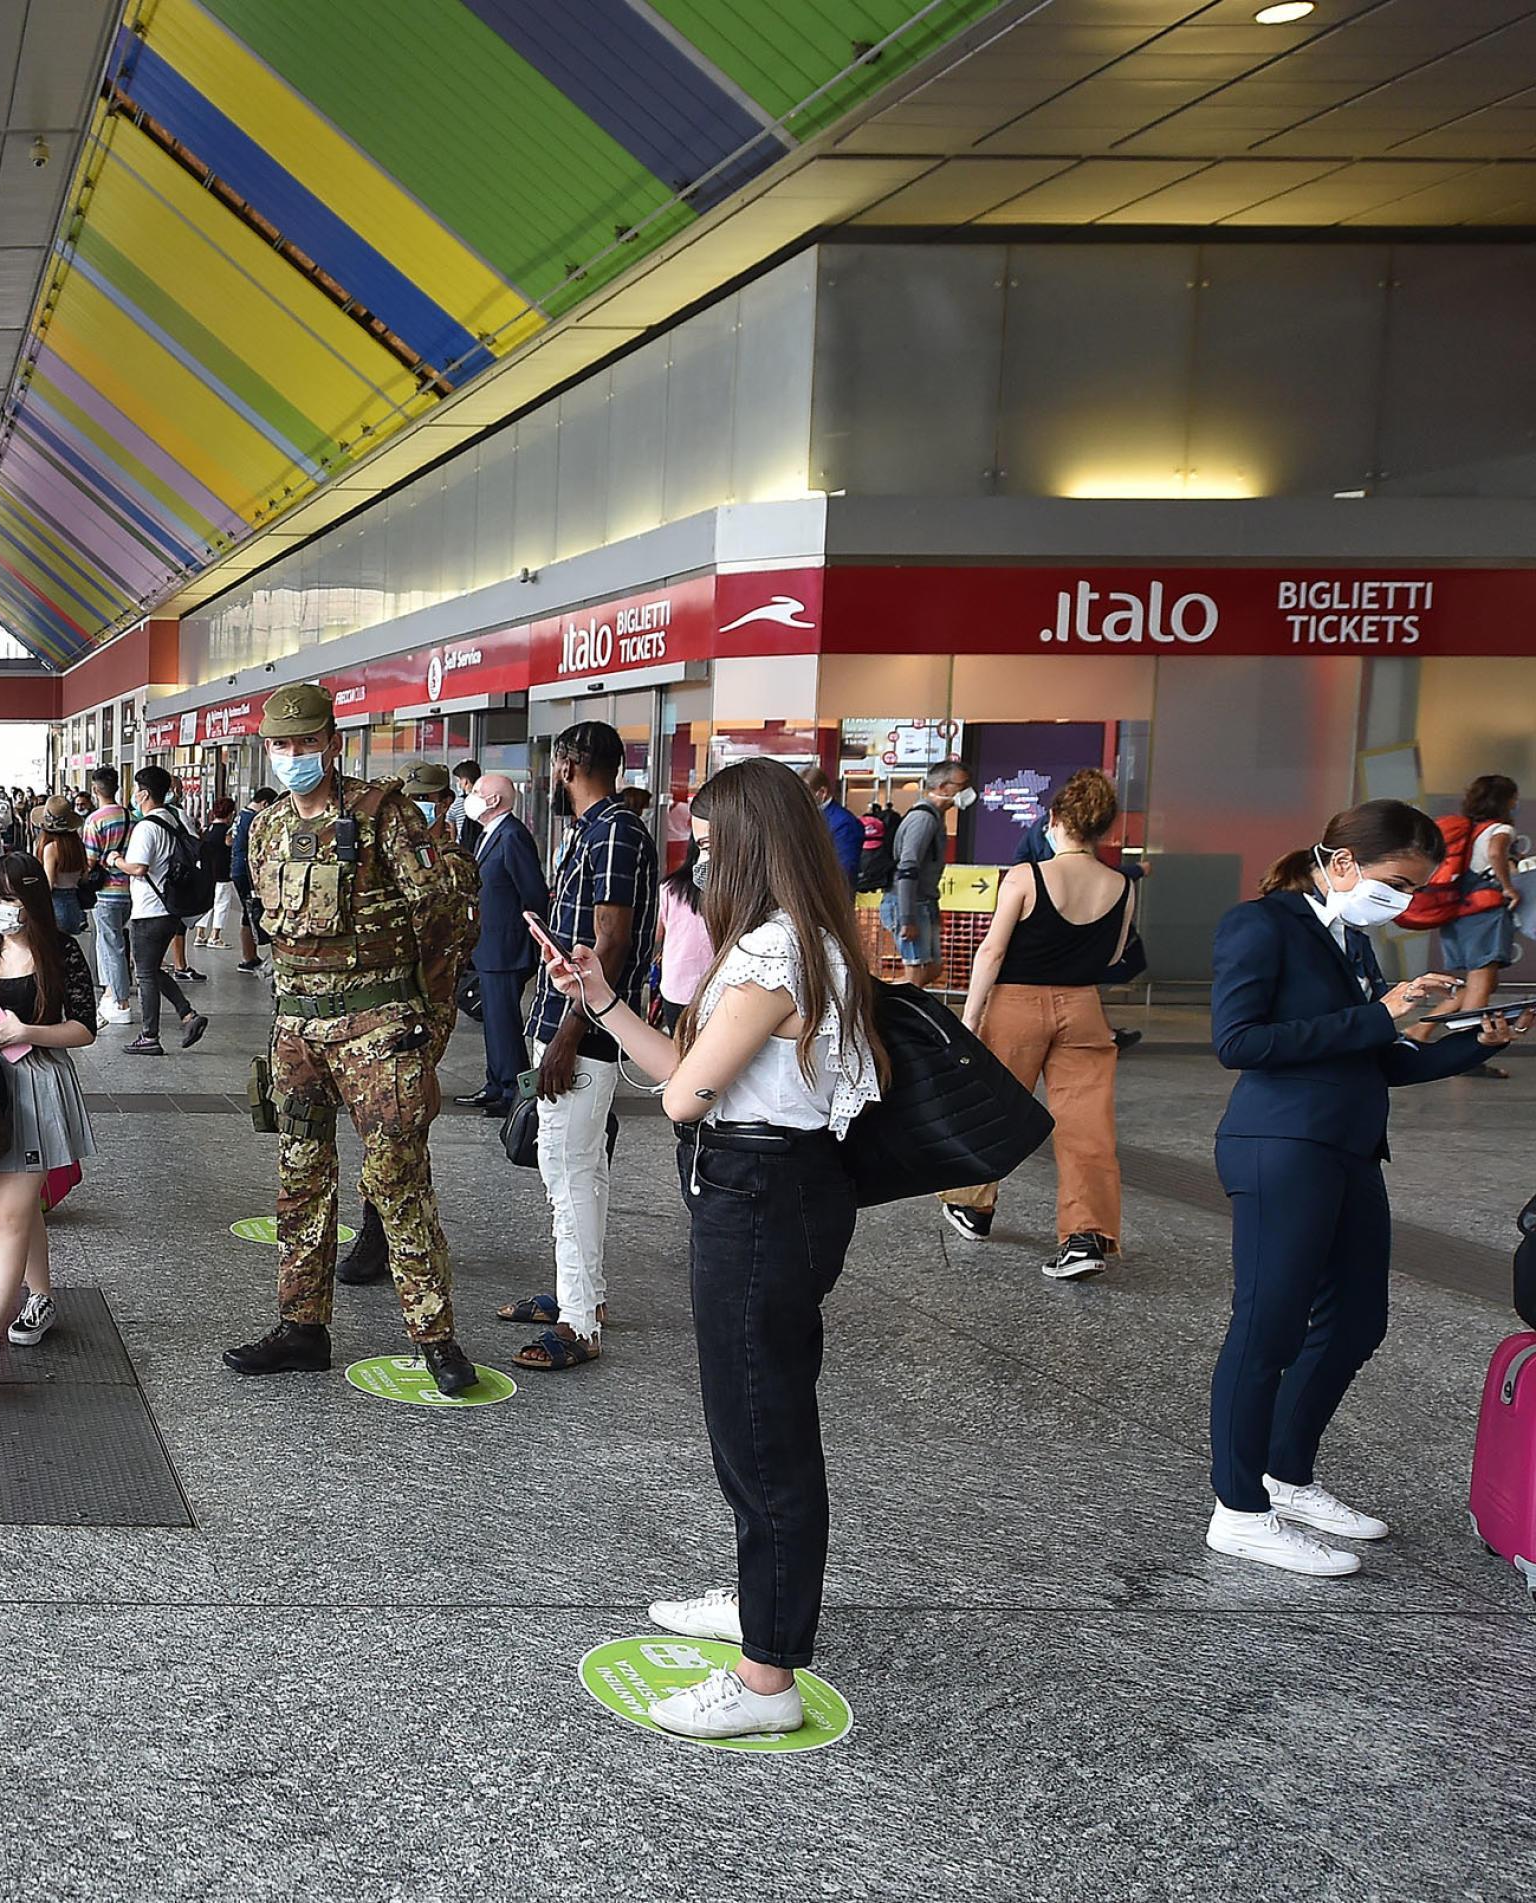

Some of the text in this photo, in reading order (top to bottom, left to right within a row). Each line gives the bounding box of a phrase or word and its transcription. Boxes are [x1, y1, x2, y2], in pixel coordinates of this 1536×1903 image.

[1277, 581, 1434, 610] BIGLIETTI
[616, 599, 671, 636] BIGLIETTI
[1285, 614, 1420, 644] TICKETS
[444, 647, 483, 670] Self Service
[619, 630, 666, 664] TICKETS
